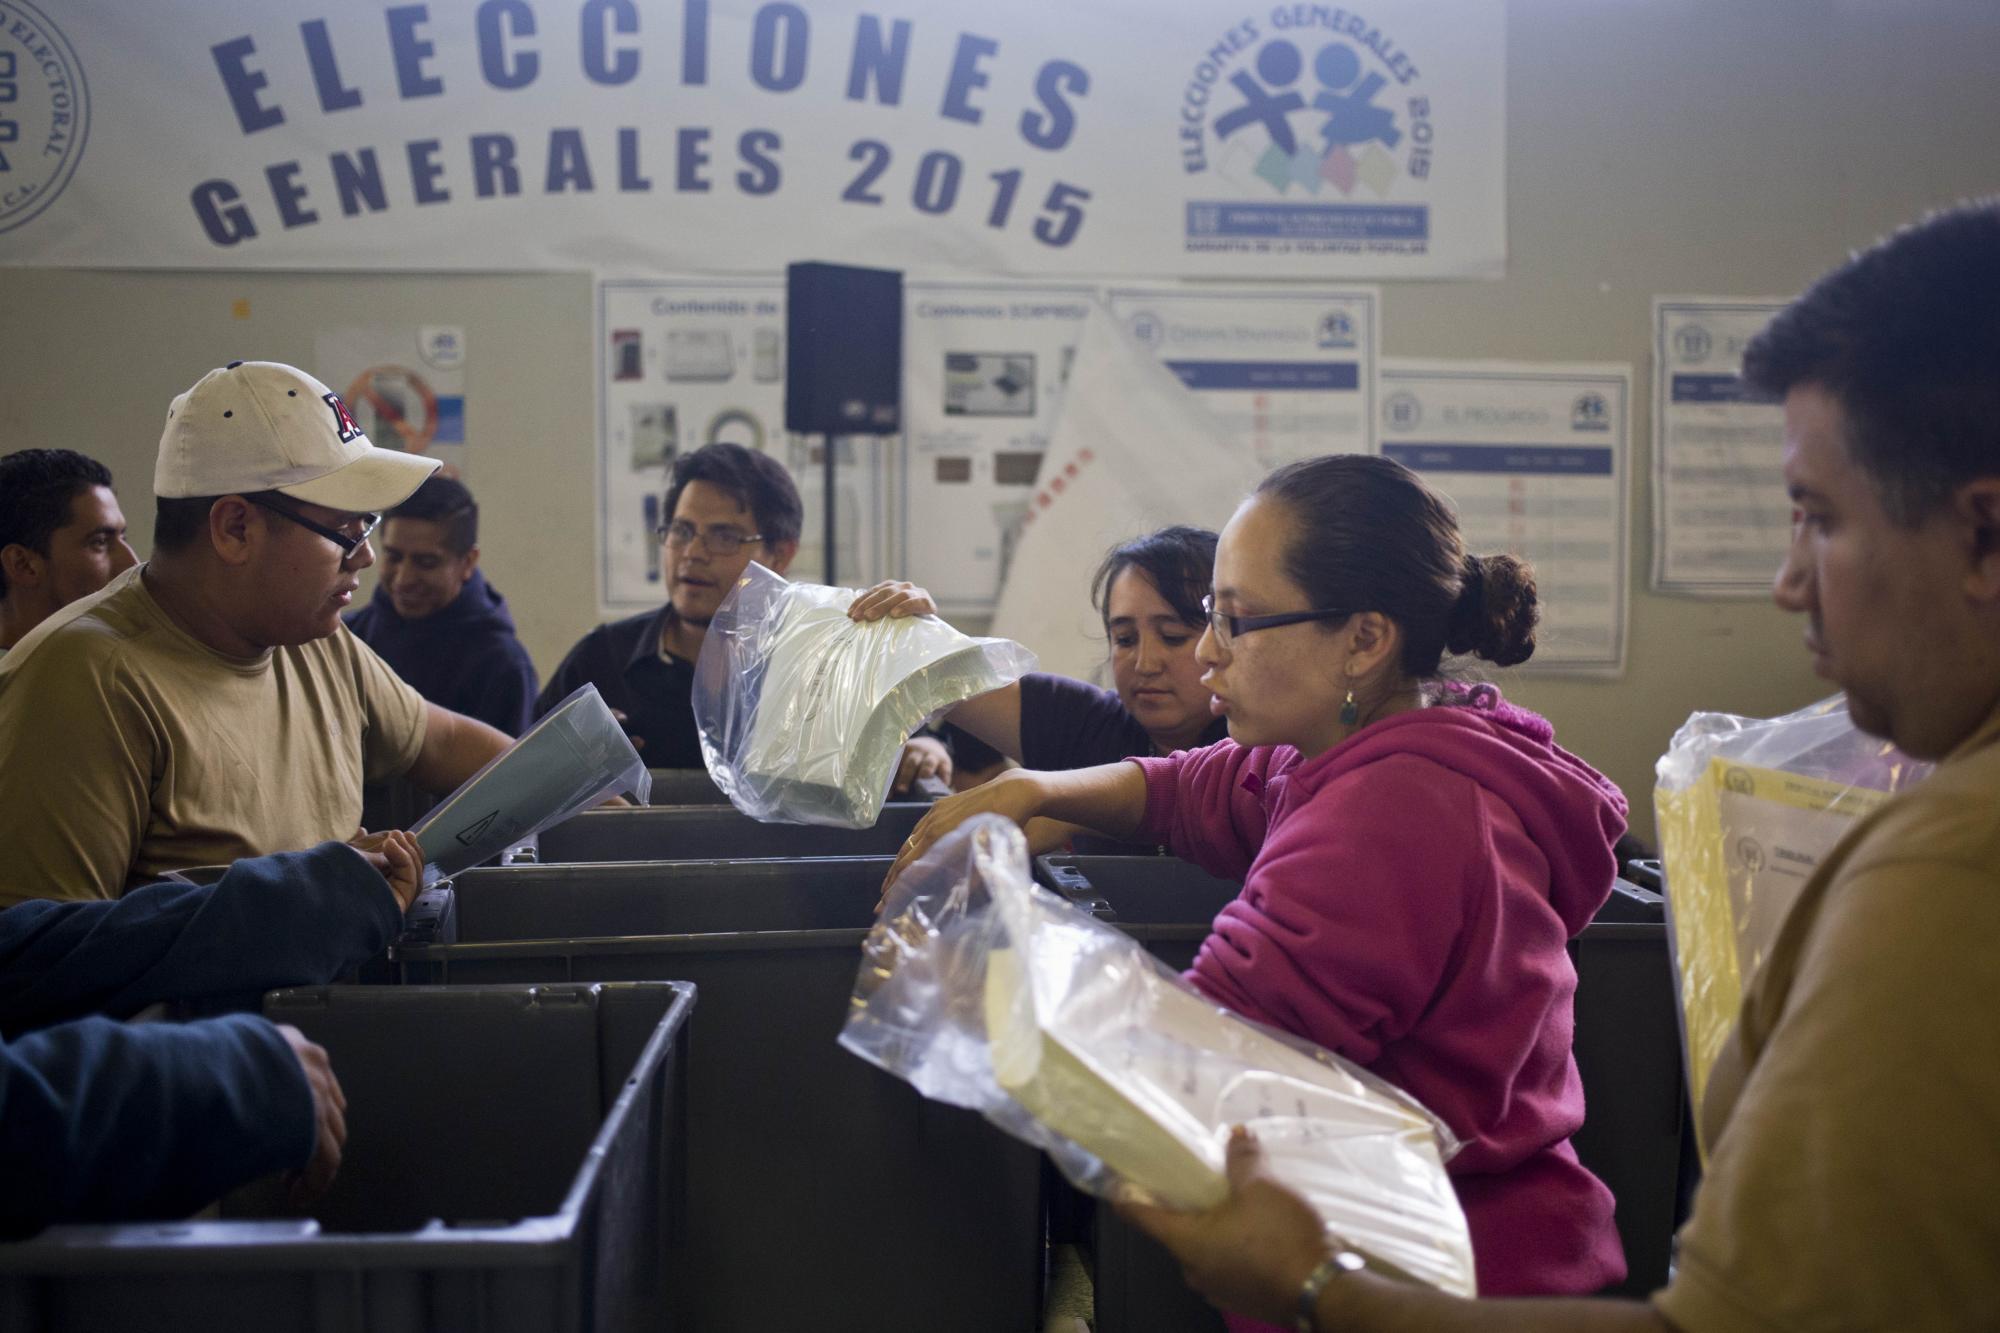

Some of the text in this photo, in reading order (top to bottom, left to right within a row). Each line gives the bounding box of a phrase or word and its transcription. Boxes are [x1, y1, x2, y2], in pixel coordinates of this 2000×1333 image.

[9, 21, 71, 157] ELECTORAL
[209, 0, 1091, 152] ELECCIONES
[1180, 18, 1260, 174] ELECCIONES
[1271, 3, 1420, 85] GENERALES
[190, 127, 1092, 248] GENERALES 2015
[322, 392, 364, 444] A
